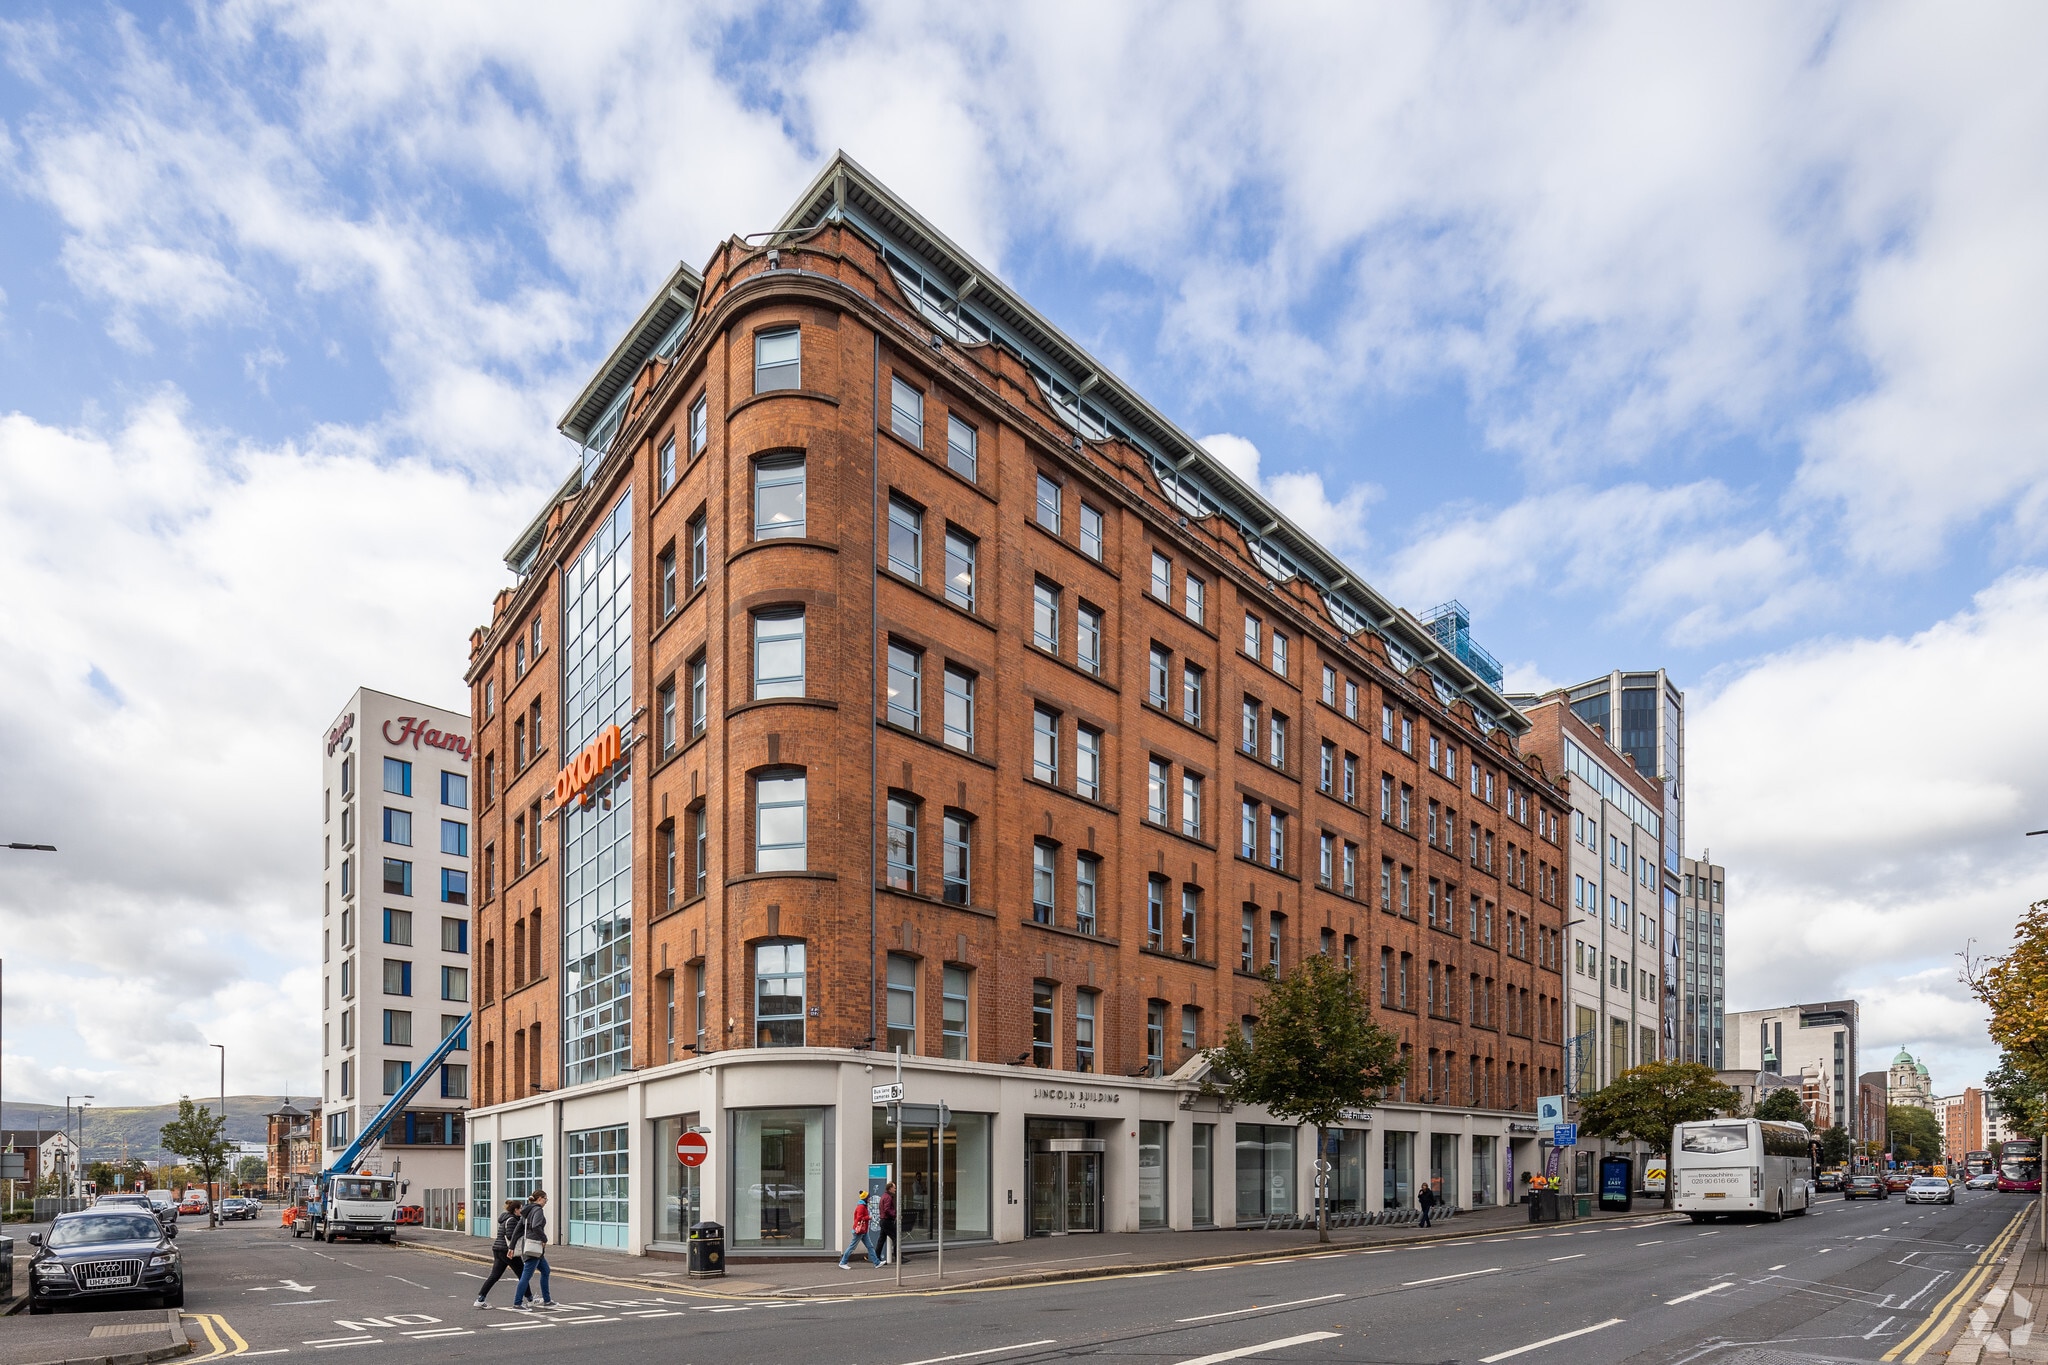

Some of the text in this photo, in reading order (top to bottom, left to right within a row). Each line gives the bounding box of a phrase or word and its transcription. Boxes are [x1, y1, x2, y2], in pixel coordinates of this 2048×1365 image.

[1033, 1088, 1120, 1103] LINCOLN BUILDING
[90, 1278, 105, 1286] UHZ
[332, 1313, 443, 1331] NO
